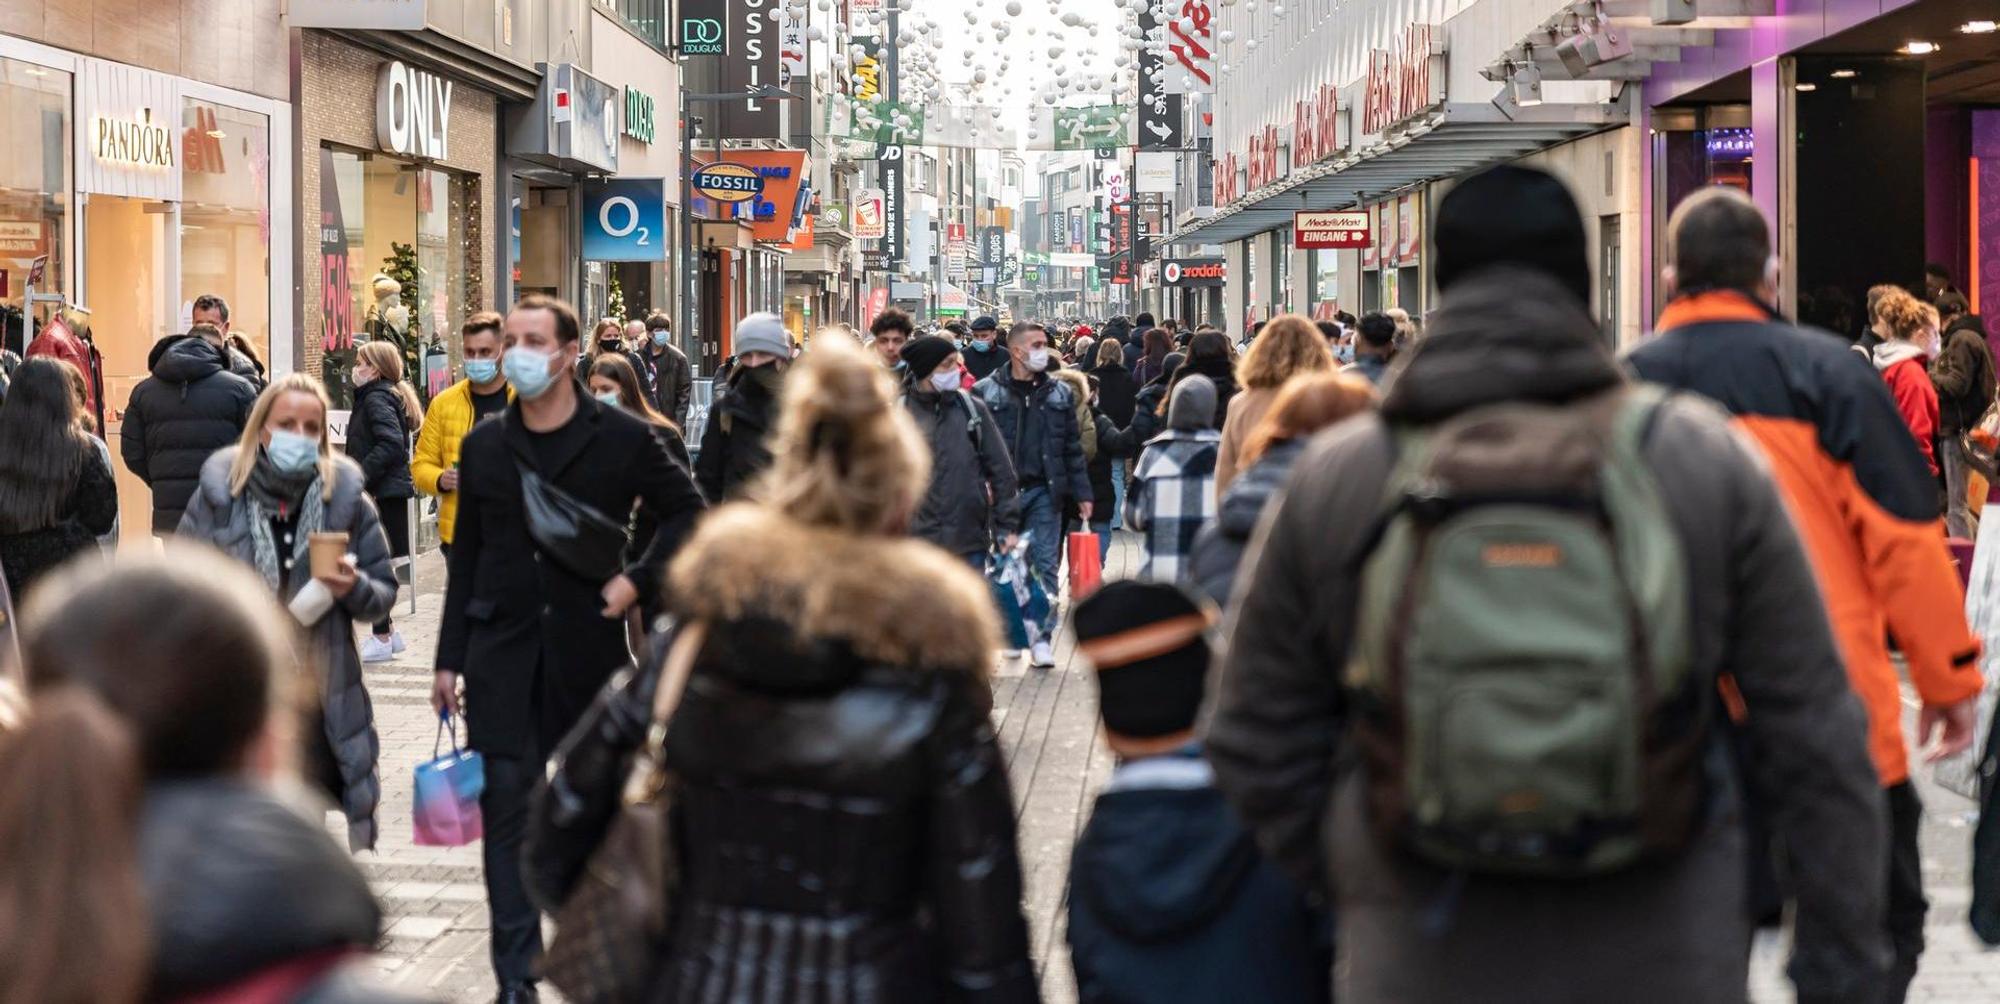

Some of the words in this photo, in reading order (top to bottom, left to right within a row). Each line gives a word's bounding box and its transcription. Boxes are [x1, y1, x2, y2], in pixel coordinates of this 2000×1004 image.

[684, 44, 721, 53] DOUGLAS
[389, 60, 452, 160] ONLY
[881, 146, 901, 160] JD
[702, 175, 759, 191] FOSSIL
[1303, 231, 1348, 242] EINGANG
